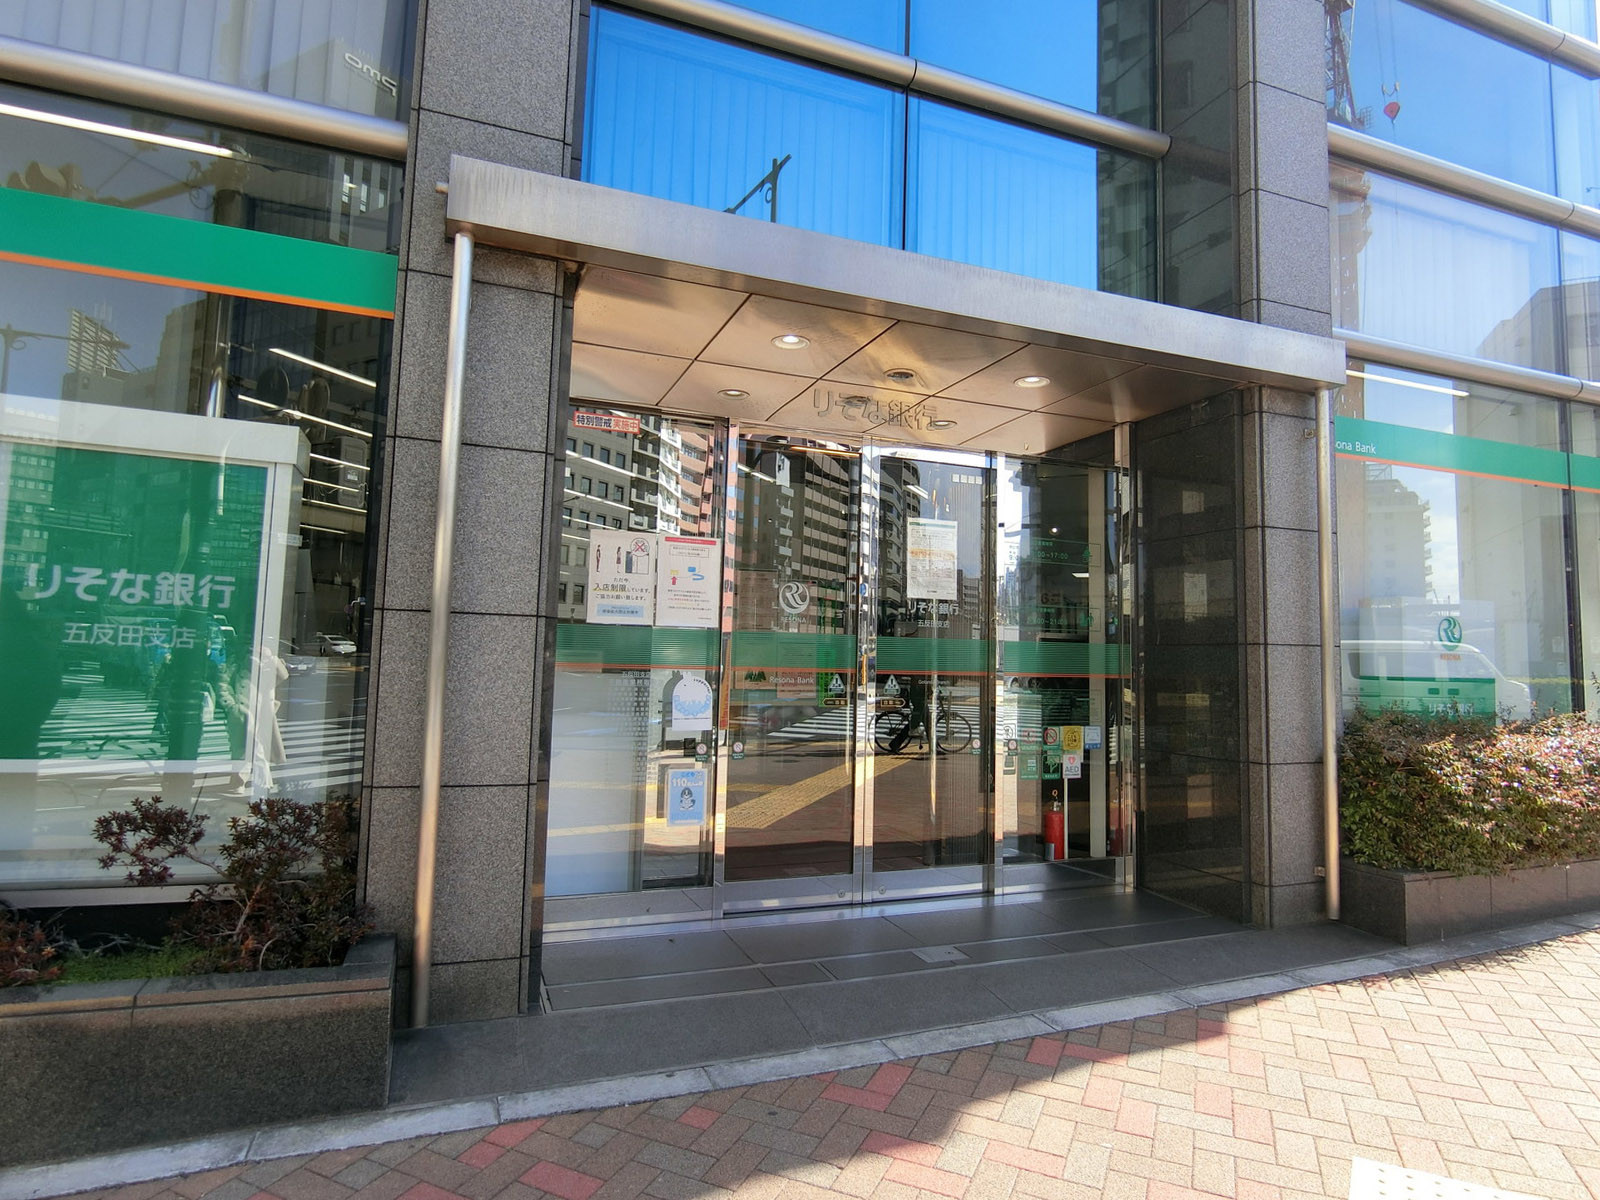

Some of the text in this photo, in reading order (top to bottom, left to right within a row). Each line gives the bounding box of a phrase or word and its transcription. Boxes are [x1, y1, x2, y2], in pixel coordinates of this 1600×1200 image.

[576, 414, 639, 431] 特別警戒実施中
[1355, 441, 1377, 455] Bank
[25, 563, 237, 609] りそな銀行
[908, 600, 959, 615] りそな銀行
[62, 622, 197, 649] 五反田支店
[769, 676, 816, 685] Resona Bank
[1065, 765, 1079, 773] AED
